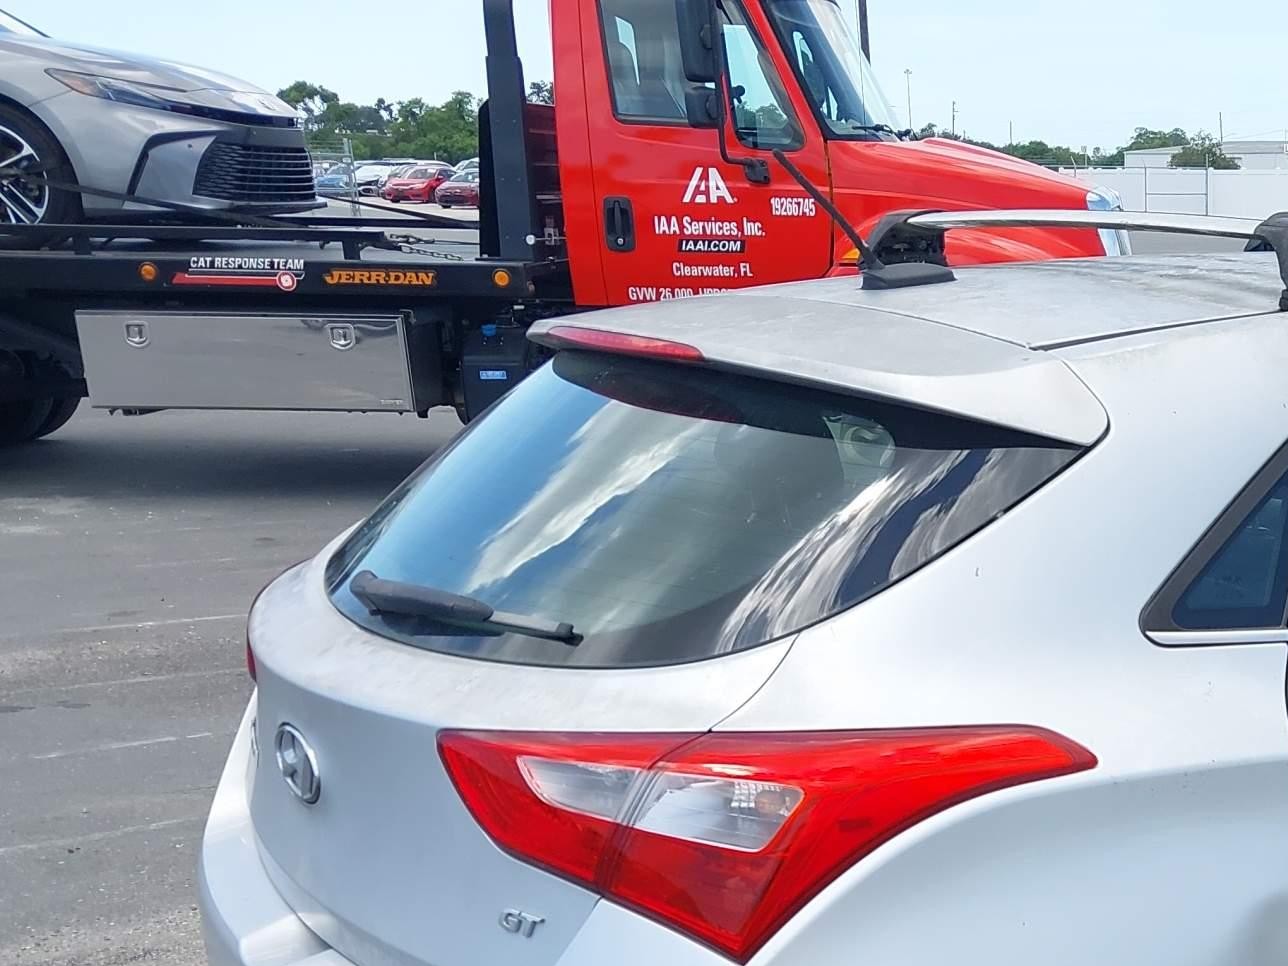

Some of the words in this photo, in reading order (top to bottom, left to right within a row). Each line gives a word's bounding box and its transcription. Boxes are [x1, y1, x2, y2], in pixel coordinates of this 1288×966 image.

[770, 198, 816, 217] 19266745
[654, 216, 680, 235] IAA
[683, 217, 742, 238] Services,
[743, 218, 766, 236] Inc.
[682, 240, 742, 252] IAAI.COM
[190, 256, 212, 269] CAT
[214, 257, 272, 270] RESPONSE
[272, 258, 305, 270] TEAM
[672, 262, 738, 278] Clearwater,
[740, 263, 754, 277] FL
[628, 286, 657, 301] GVW
[498, 908, 546, 938] GT
